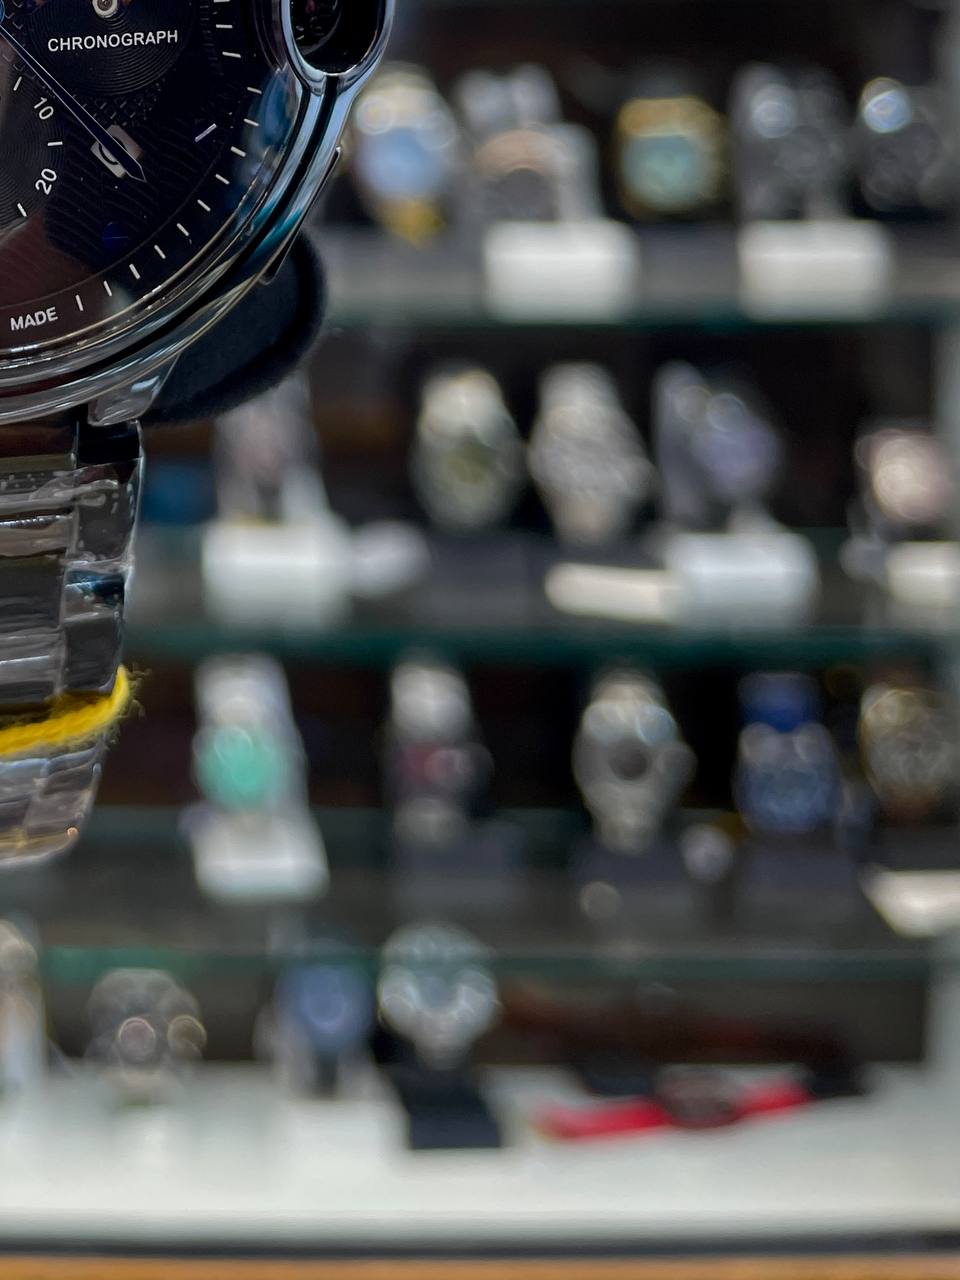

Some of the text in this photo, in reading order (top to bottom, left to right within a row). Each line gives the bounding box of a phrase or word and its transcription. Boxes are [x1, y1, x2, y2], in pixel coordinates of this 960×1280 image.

[47, 29, 179, 52] CHRONOGRAPH
[34, 97, 54, 120] 10
[35, 168, 58, 195] 20
[10, 306, 58, 332] MADE
